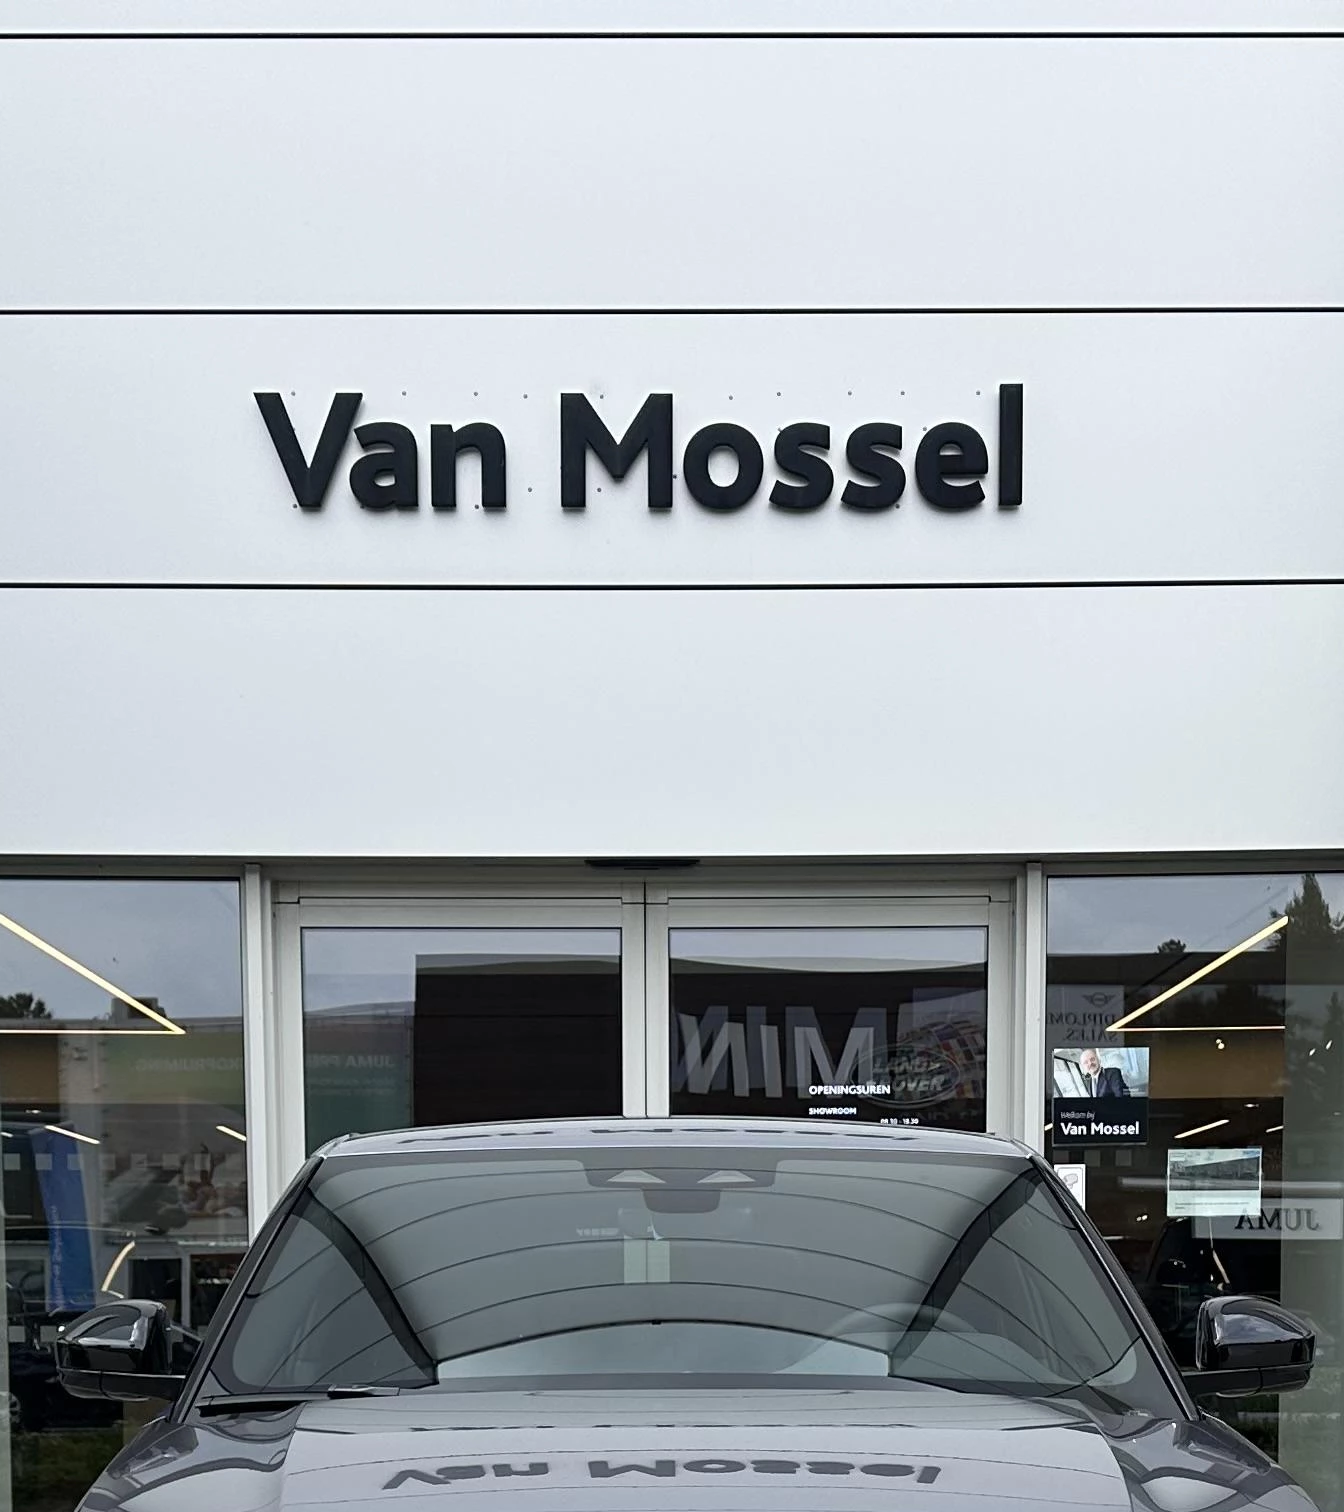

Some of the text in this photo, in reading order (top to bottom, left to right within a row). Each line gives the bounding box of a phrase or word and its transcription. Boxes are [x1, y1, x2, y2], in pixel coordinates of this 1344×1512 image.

[252, 383, 1024, 512] Van Mossel
[808, 1084, 891, 1096] OPENINGSUREN
[808, 1107, 857, 1115] SHOWROOM
[1060, 1121, 1140, 1136] Van Mossel
